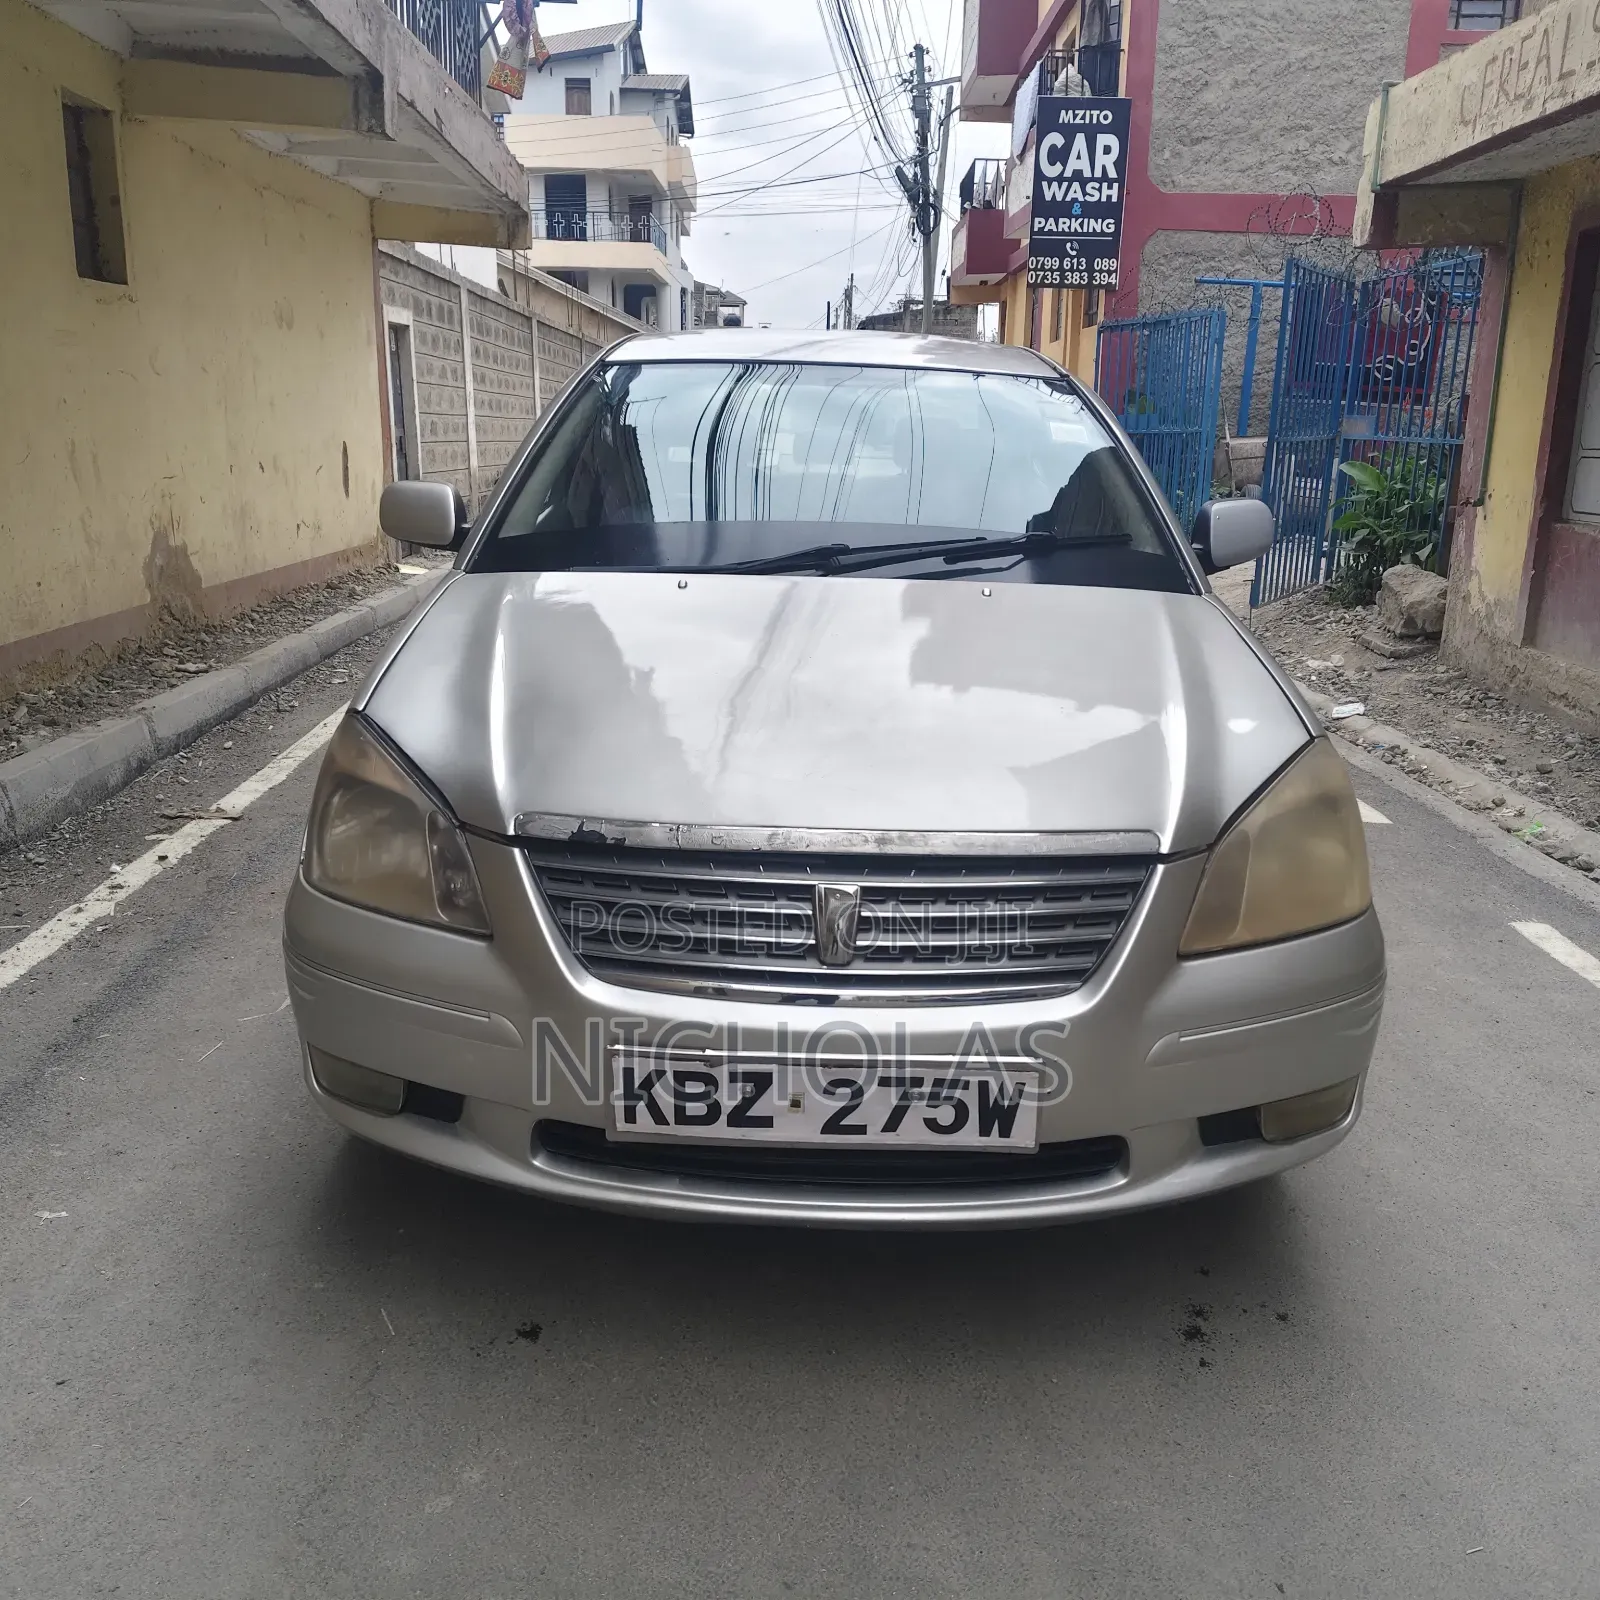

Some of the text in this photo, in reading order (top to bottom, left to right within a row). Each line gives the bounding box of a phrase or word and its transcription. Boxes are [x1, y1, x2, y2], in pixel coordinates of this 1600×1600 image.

[1059, 109, 1113, 124] MZITO
[1039, 131, 1120, 179] CAR
[1042, 181, 1119, 202] WASH
[1071, 202, 1082, 215] &
[1033, 217, 1115, 233] PARKING
[1028, 257, 1117, 271] 0799 613 089
[1027, 271, 1117, 285] 0735 383 394
[621, 1066, 1027, 1140] KBZ 275W
